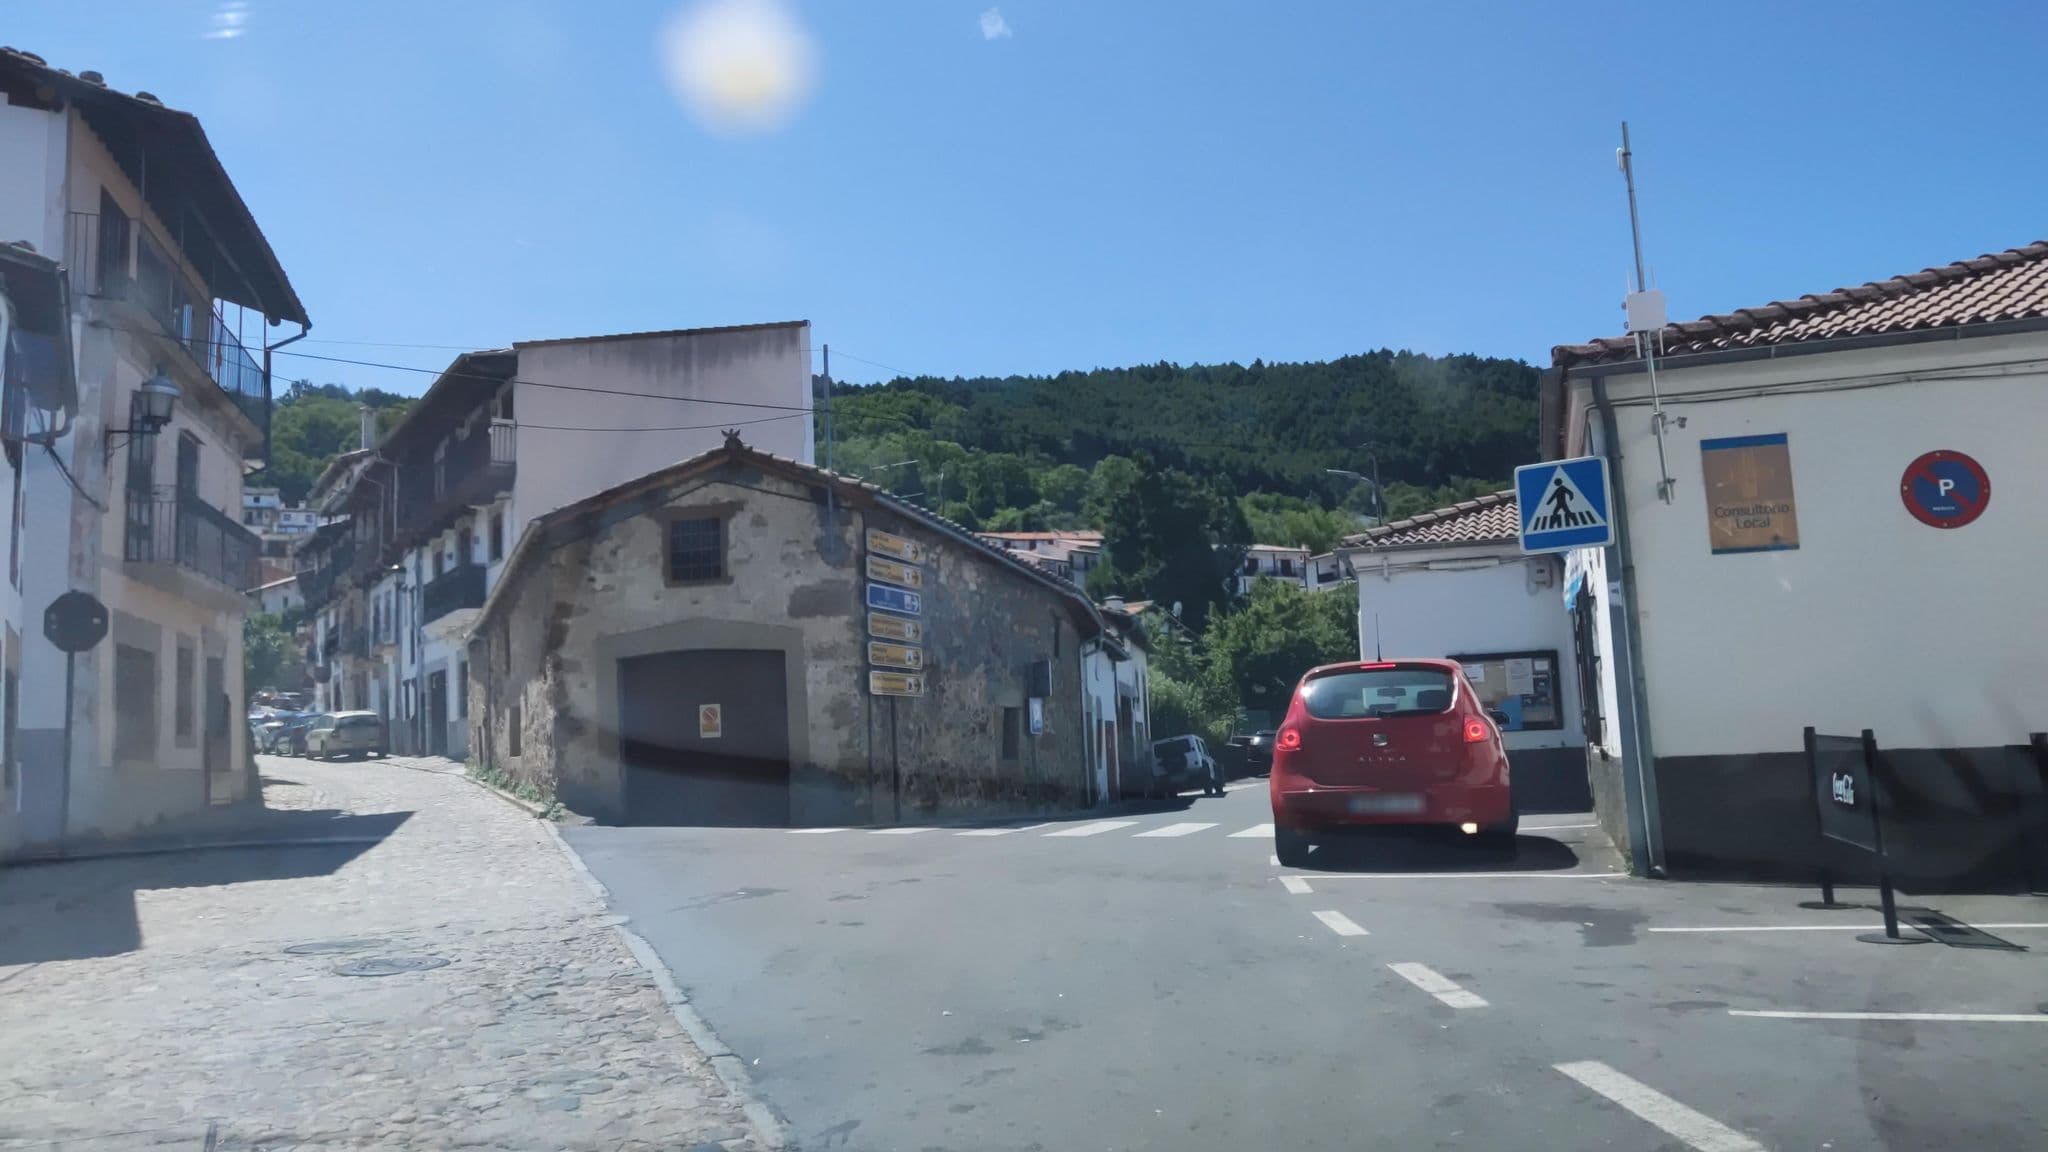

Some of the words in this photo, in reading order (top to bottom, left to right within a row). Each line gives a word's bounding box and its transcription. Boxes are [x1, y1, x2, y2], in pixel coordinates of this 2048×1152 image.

[1939, 479, 1955, 497] P
[1714, 503, 1790, 518] Consultorio
[1736, 517, 1771, 529] Local
